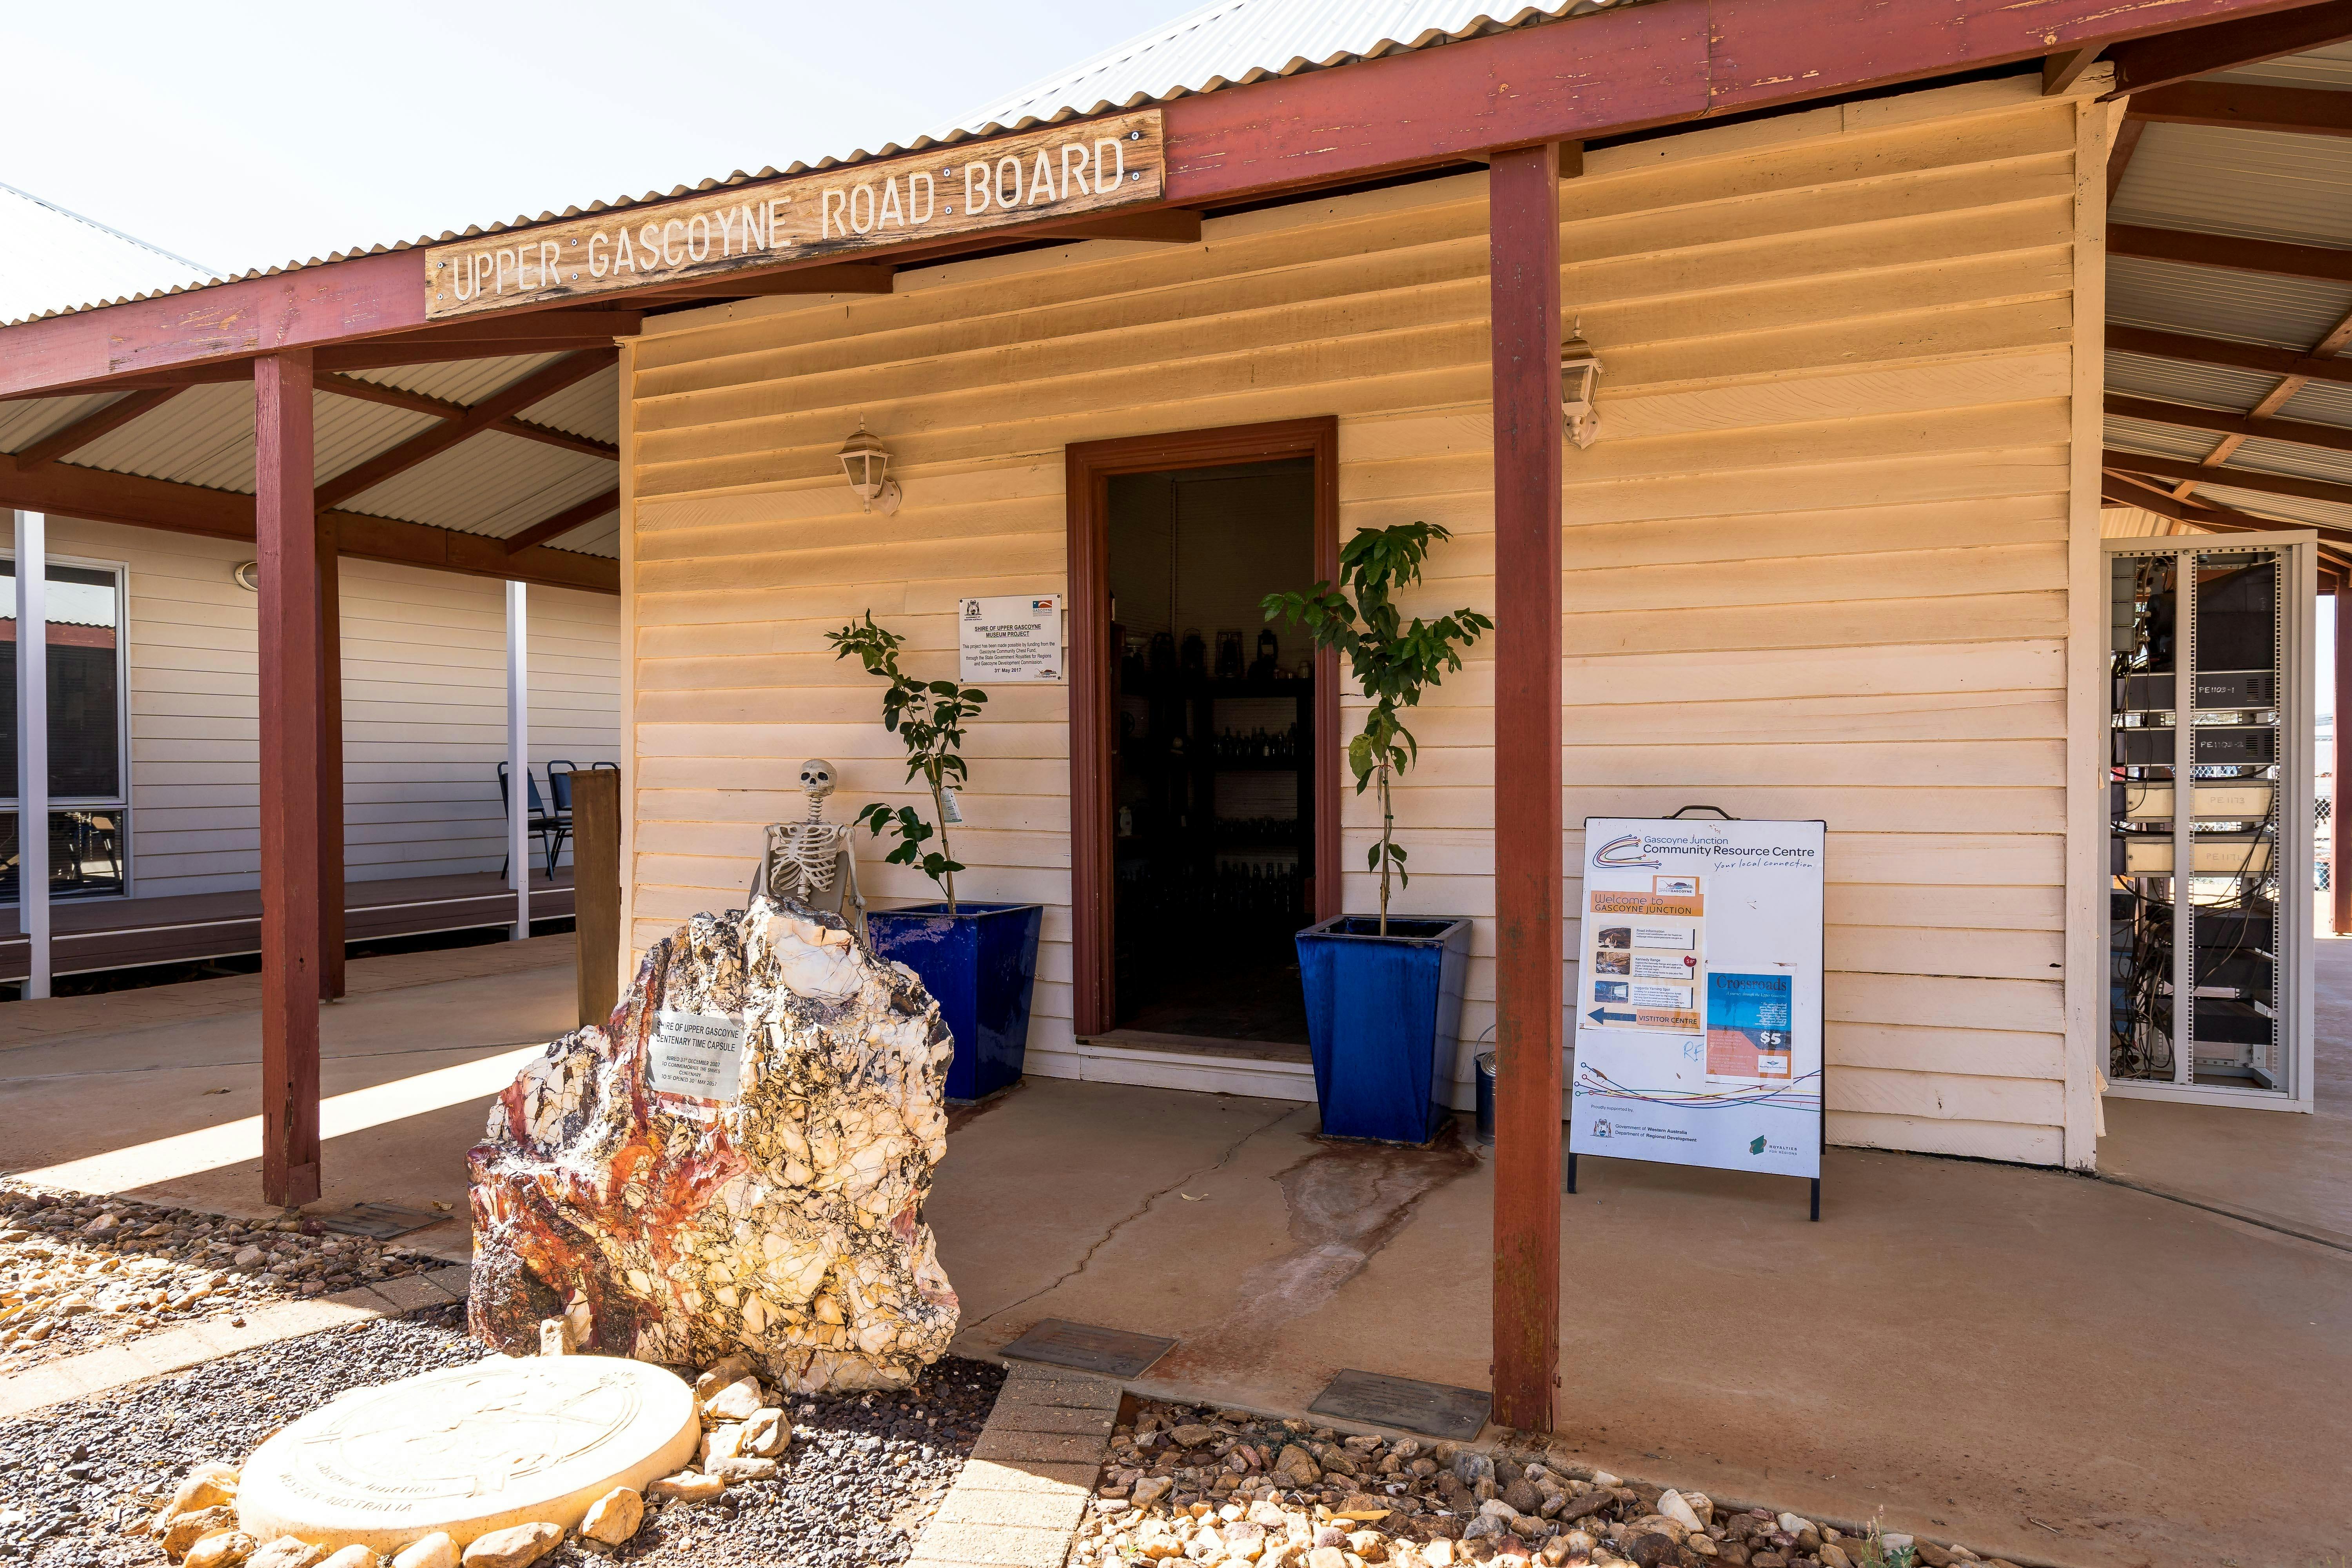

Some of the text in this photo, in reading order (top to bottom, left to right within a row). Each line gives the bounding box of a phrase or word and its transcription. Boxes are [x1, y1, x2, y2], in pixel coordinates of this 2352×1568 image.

[454, 137, 1124, 301] UPPER GASCOYNE ROAD BOARD
[1644, 836, 1728, 845] Gascoyne Junction
[1643, 844, 1814, 857] Community Resource Centre
[1714, 858, 1812, 872] Your local connection
[1595, 894, 1663, 906] Welcome to
[1595, 904, 1691, 914] GASCOYNE JUNCTION
[1717, 975, 1787, 991] Crossroads
[657, 1021, 739, 1038] SHIRE OF UPPER GASCOYNE
[657, 1034, 736, 1052] CENTENARY TIME CAPSULE
[1760, 1031, 1781, 1045] $5
[668, 1062, 699, 1071] COMMEMORATE
[325, 1495, 412, 1512] AUSTRALIA
